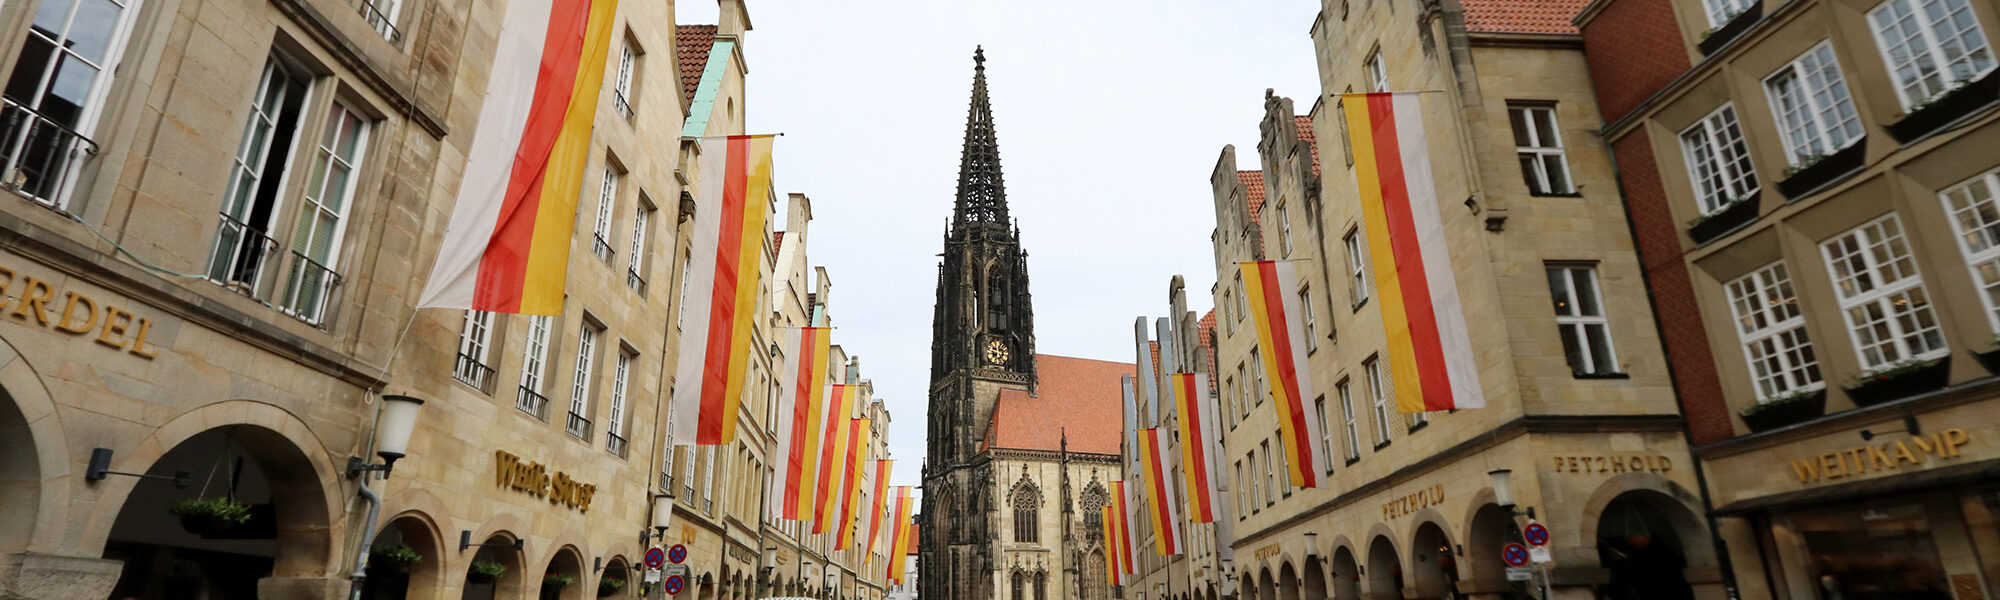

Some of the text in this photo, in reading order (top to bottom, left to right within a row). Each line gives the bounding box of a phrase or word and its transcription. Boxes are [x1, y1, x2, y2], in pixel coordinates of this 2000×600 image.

[1553, 455, 1673, 475] PETZHOLD
[1791, 428, 1969, 483] WEITKAMP
[1381, 483, 1446, 521] PETZHOLD
